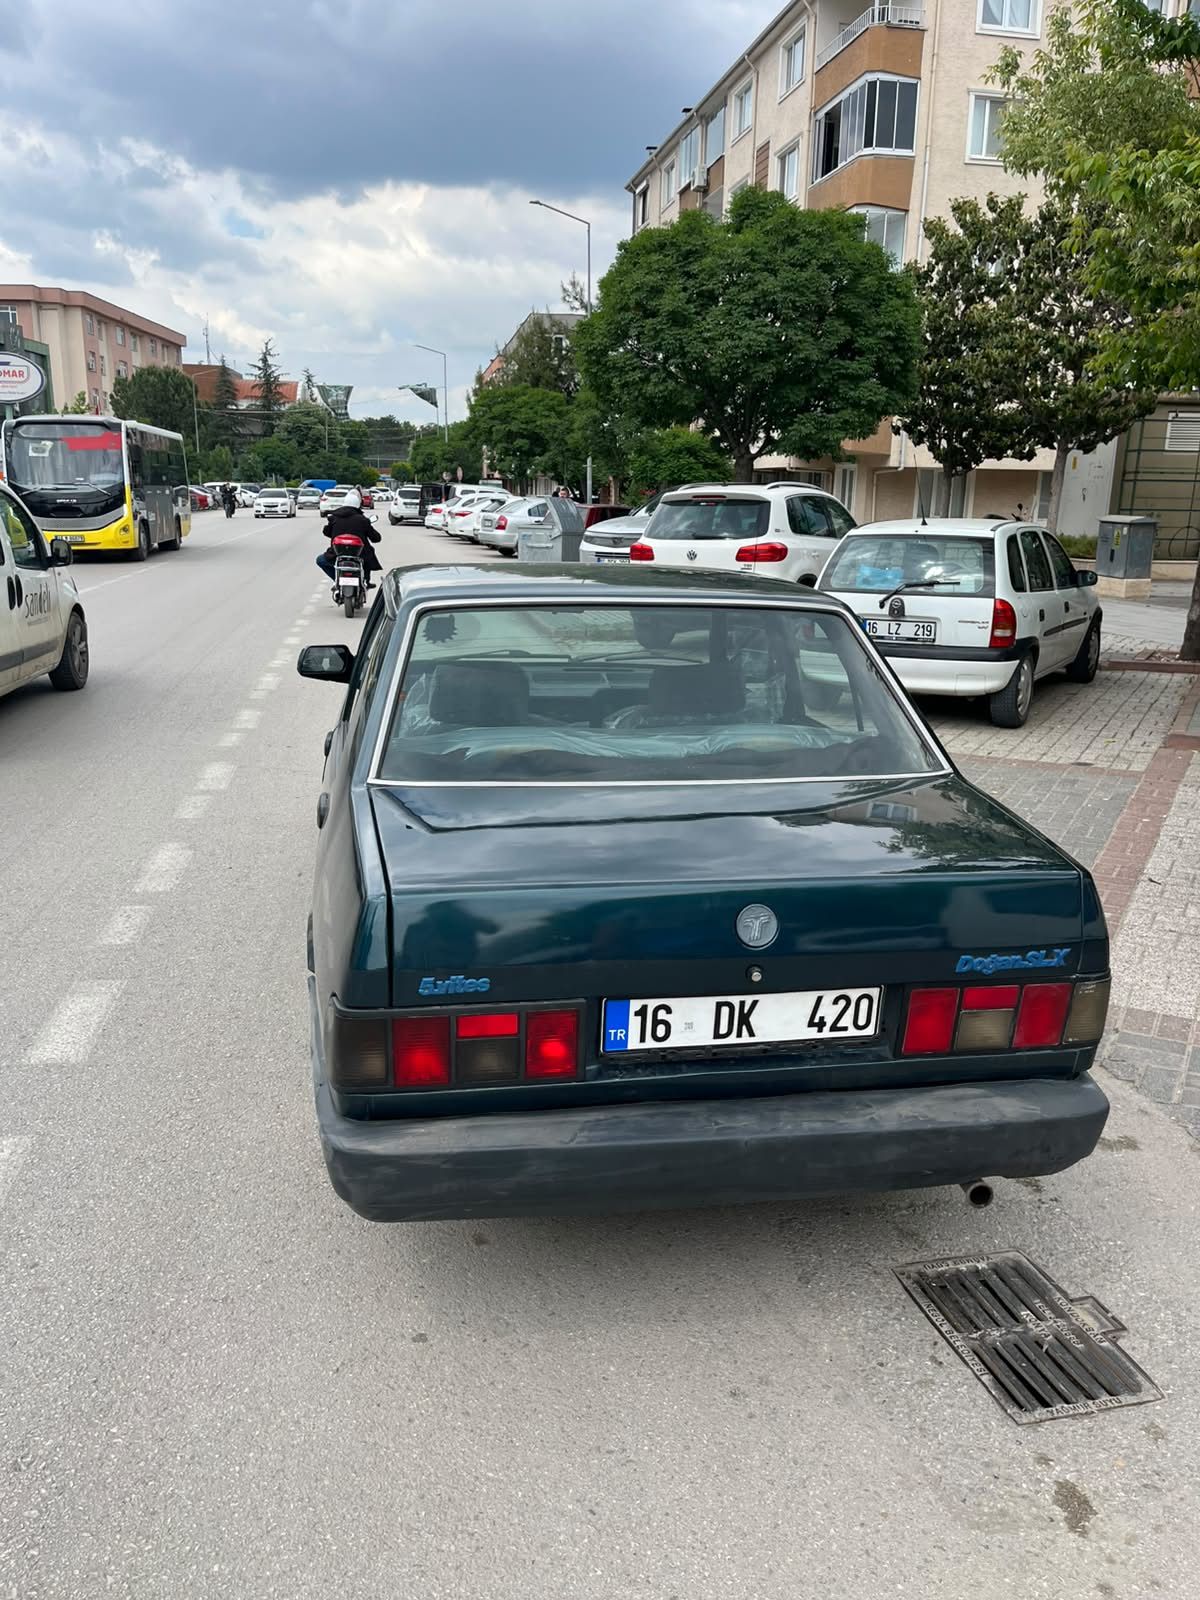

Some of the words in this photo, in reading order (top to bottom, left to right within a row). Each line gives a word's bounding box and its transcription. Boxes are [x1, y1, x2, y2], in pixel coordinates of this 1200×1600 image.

[0, 369, 25, 379] MAR
[867, 621, 879, 635] 16
[887, 622, 902, 636] LZ
[914, 623, 933, 638] 219
[633, 1003, 674, 1044] 16
[712, 999, 761, 1041] DK
[807, 992, 876, 1034] 420
[608, 1029, 627, 1042] TR
